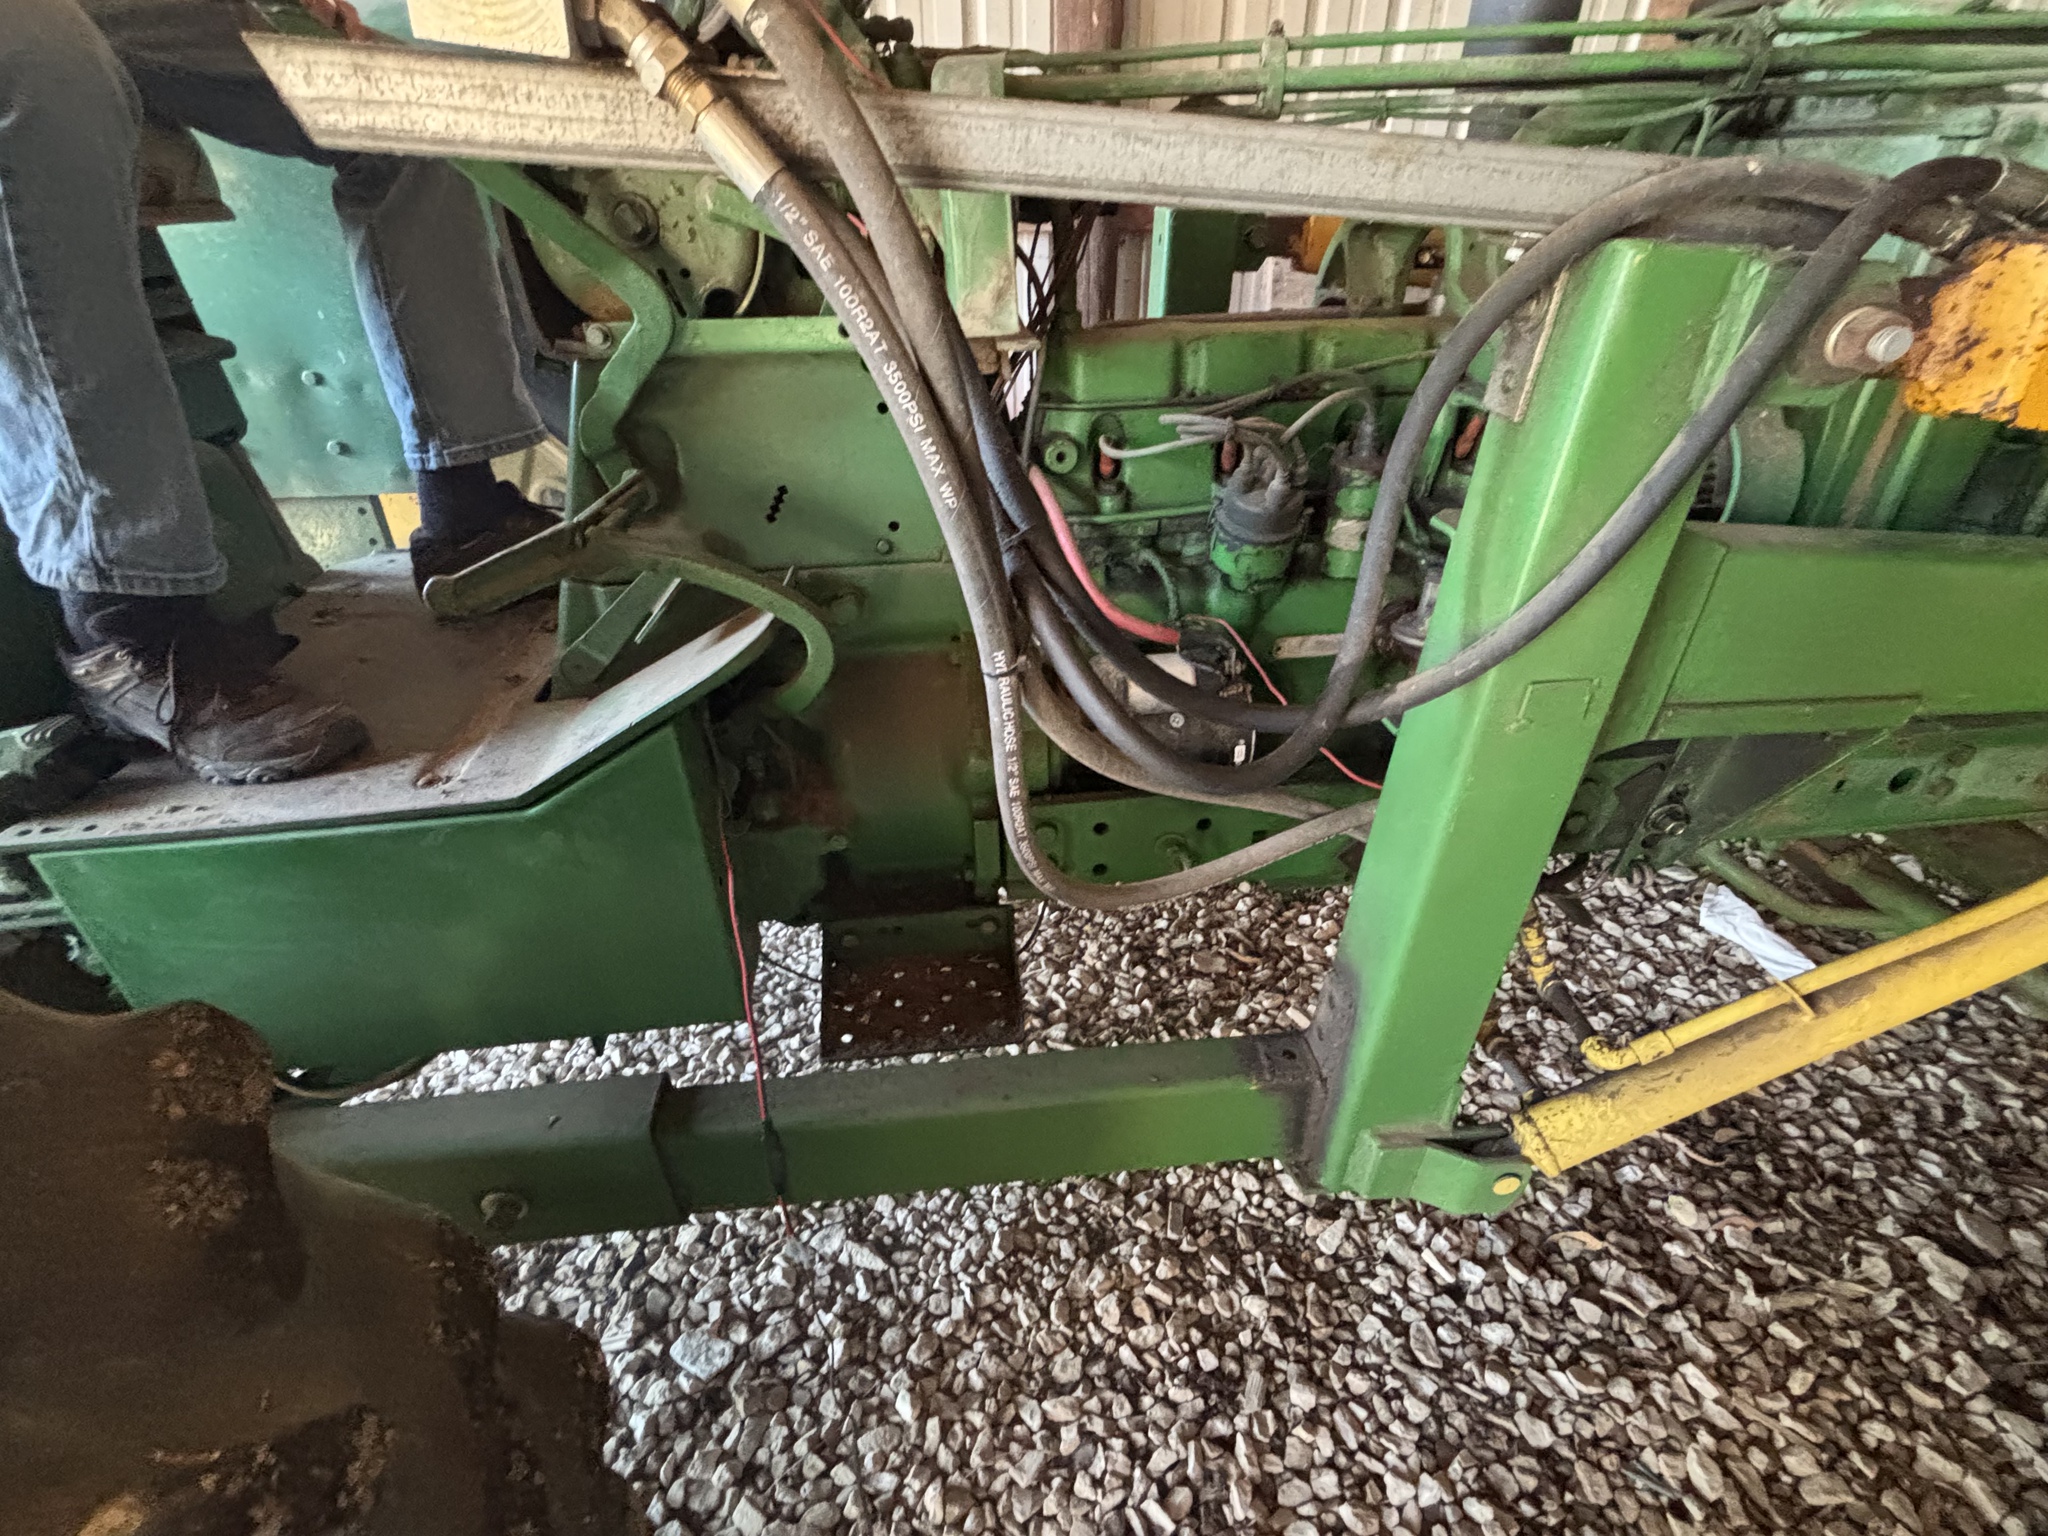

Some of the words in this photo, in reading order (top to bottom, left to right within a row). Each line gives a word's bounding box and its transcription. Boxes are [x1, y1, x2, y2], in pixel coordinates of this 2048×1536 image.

[774, 192, 808, 225] 1/2"
[803, 229, 835, 272] SAE
[833, 275, 888, 354] 100R2AT
[883, 360, 927, 433] 3500PSI
[920, 437, 946, 478] MAX
[939, 481, 958, 509] WP
[1003, 721, 1018, 752] HOSE
[1008, 777, 1021, 799] SAE
